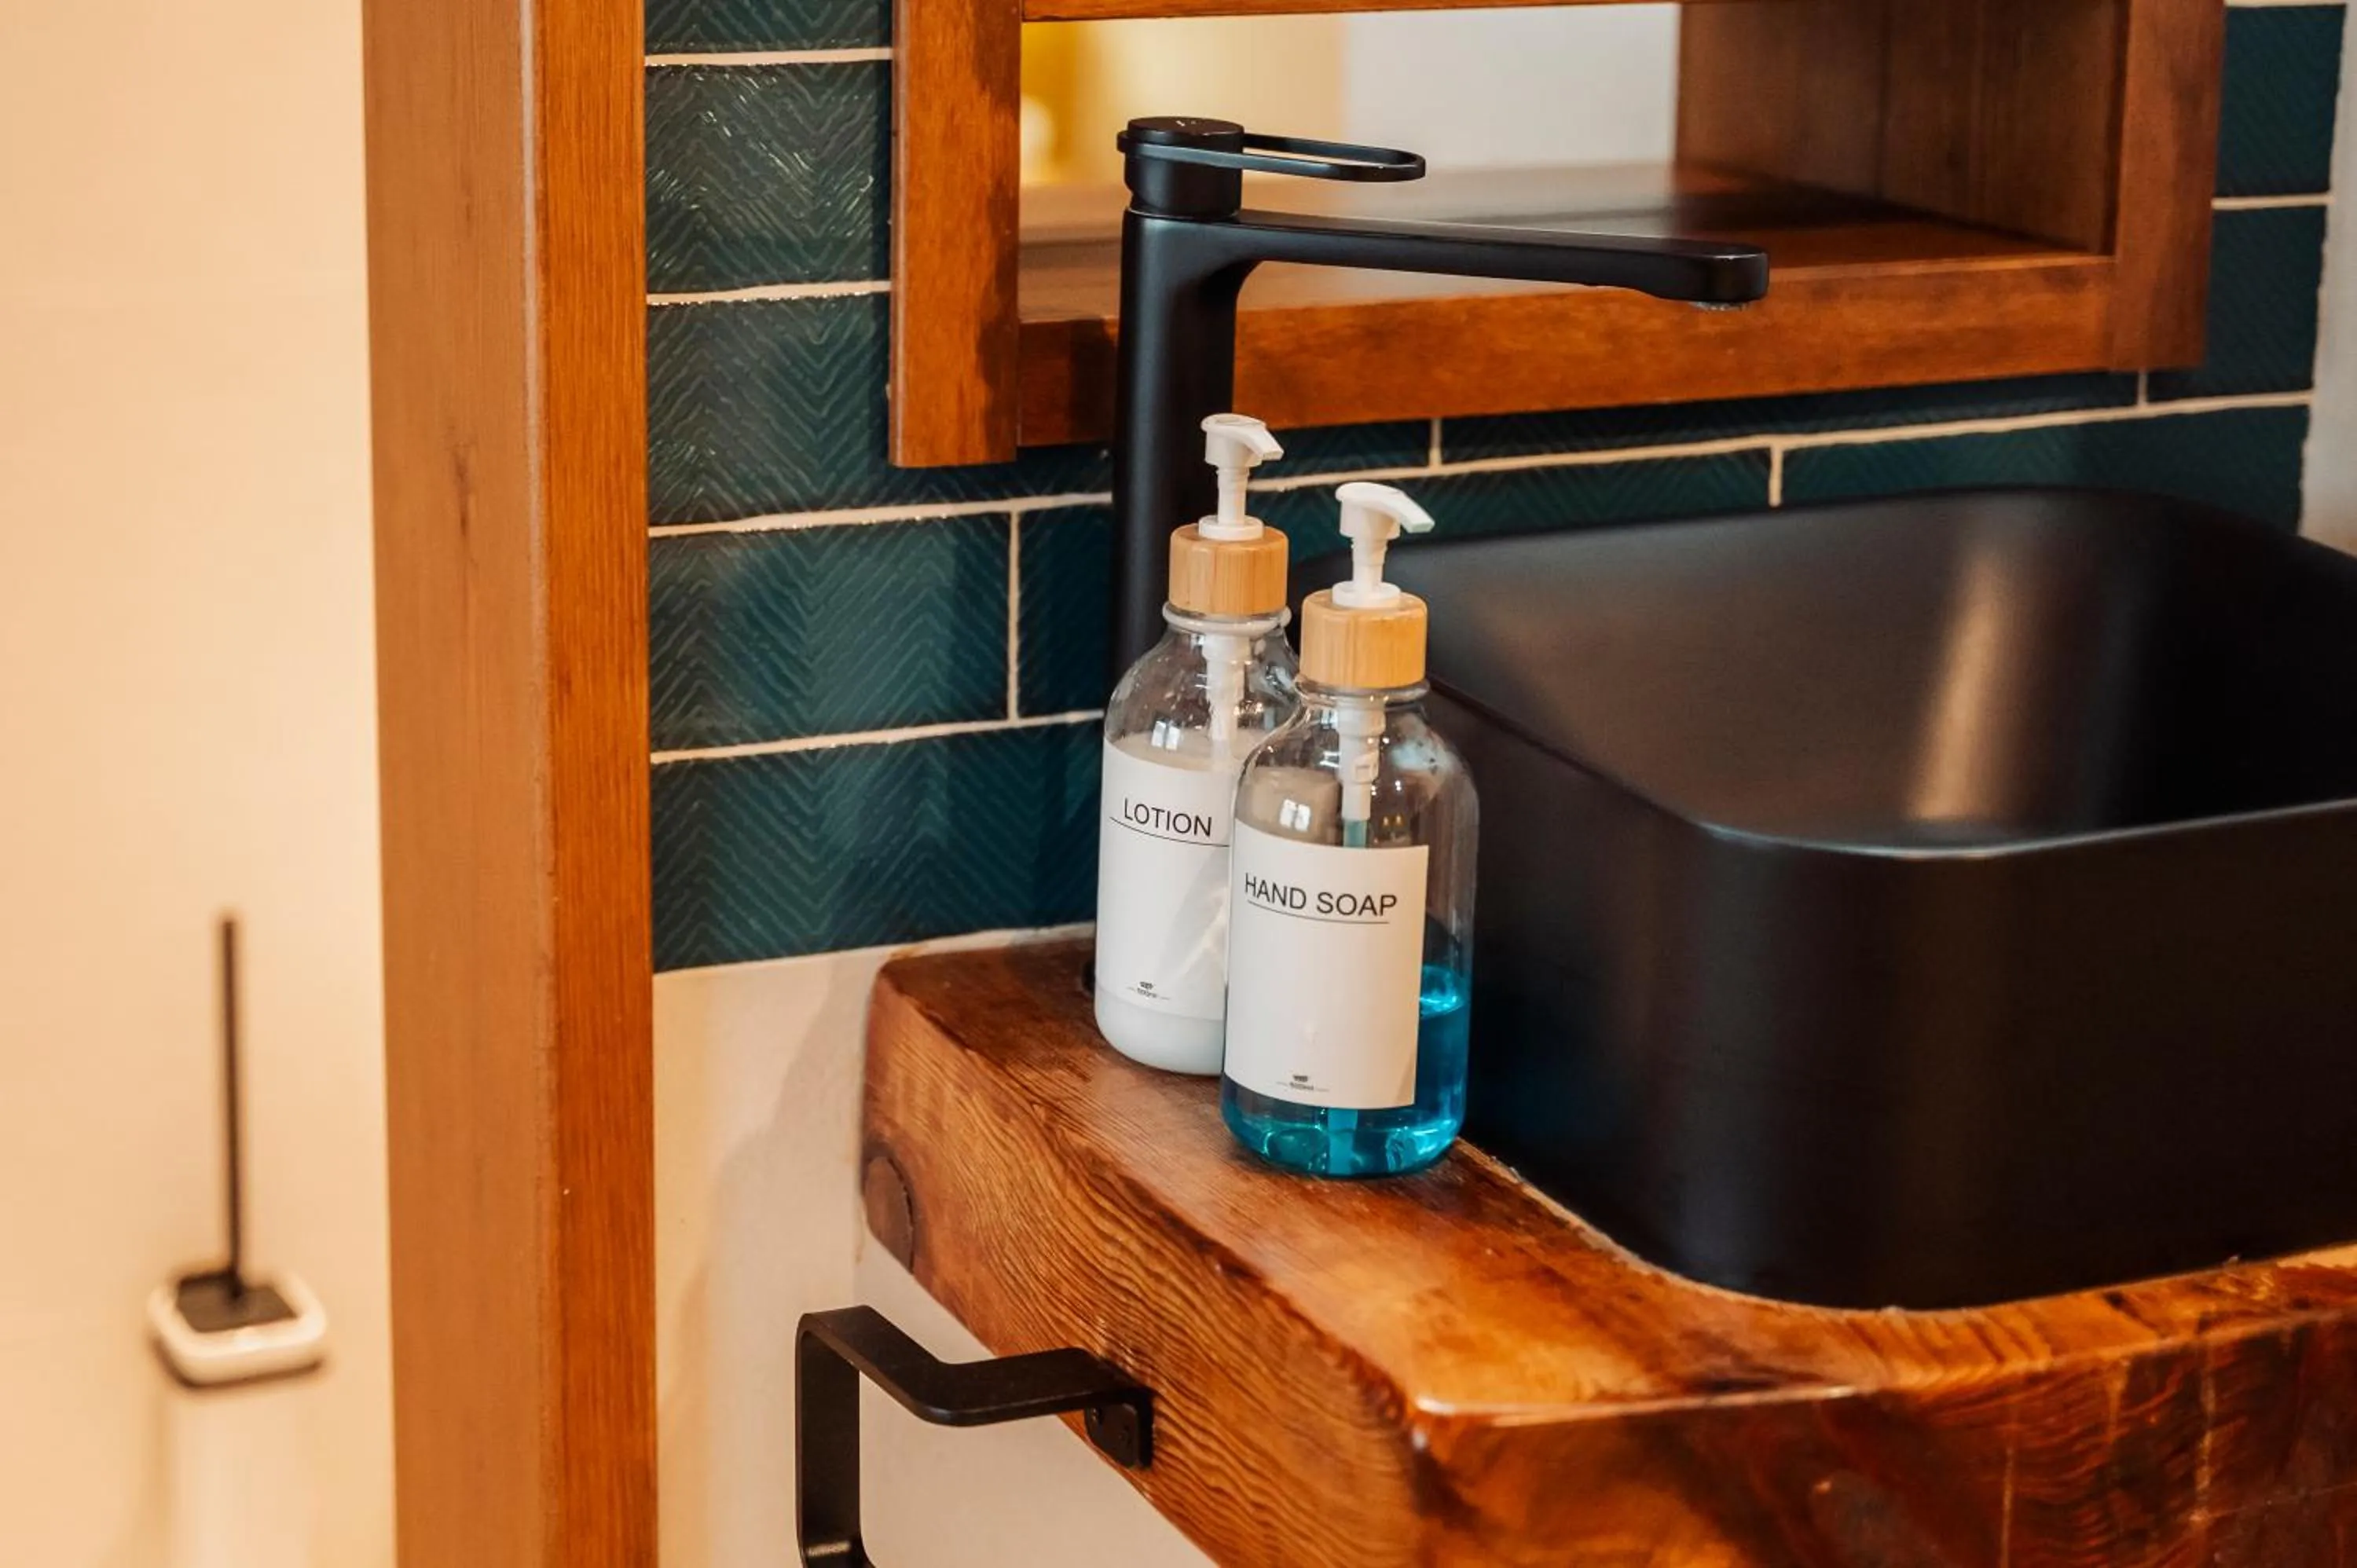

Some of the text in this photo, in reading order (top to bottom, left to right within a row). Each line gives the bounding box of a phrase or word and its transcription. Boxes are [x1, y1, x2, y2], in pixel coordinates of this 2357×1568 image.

[1124, 798, 1211, 837] LOTION
[1244, 873, 1397, 917] HAND SOAP
